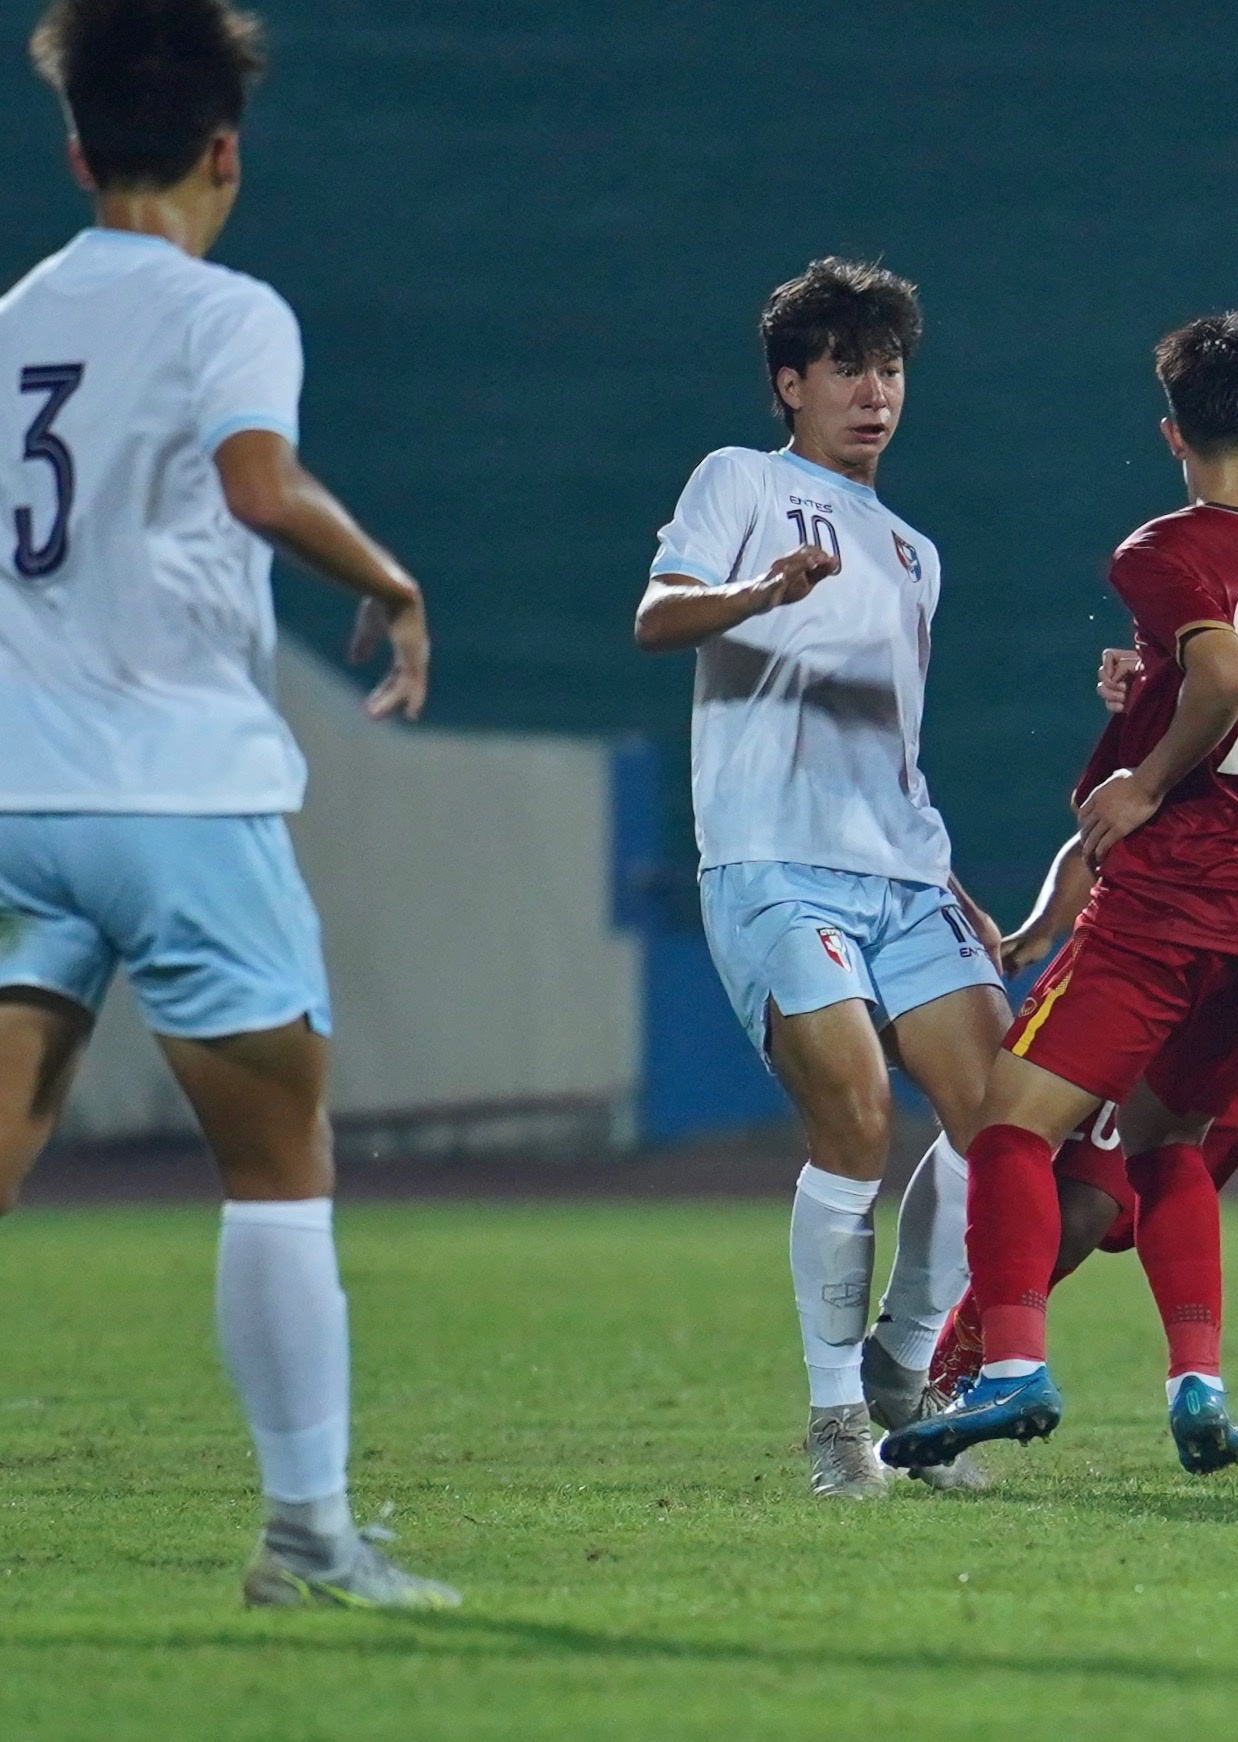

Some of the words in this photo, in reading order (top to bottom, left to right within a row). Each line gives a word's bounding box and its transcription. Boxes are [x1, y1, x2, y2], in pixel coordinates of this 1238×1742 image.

[14, 363, 85, 577] 3
[789, 495, 833, 513] ENTES
[787, 509, 842, 576] 10
